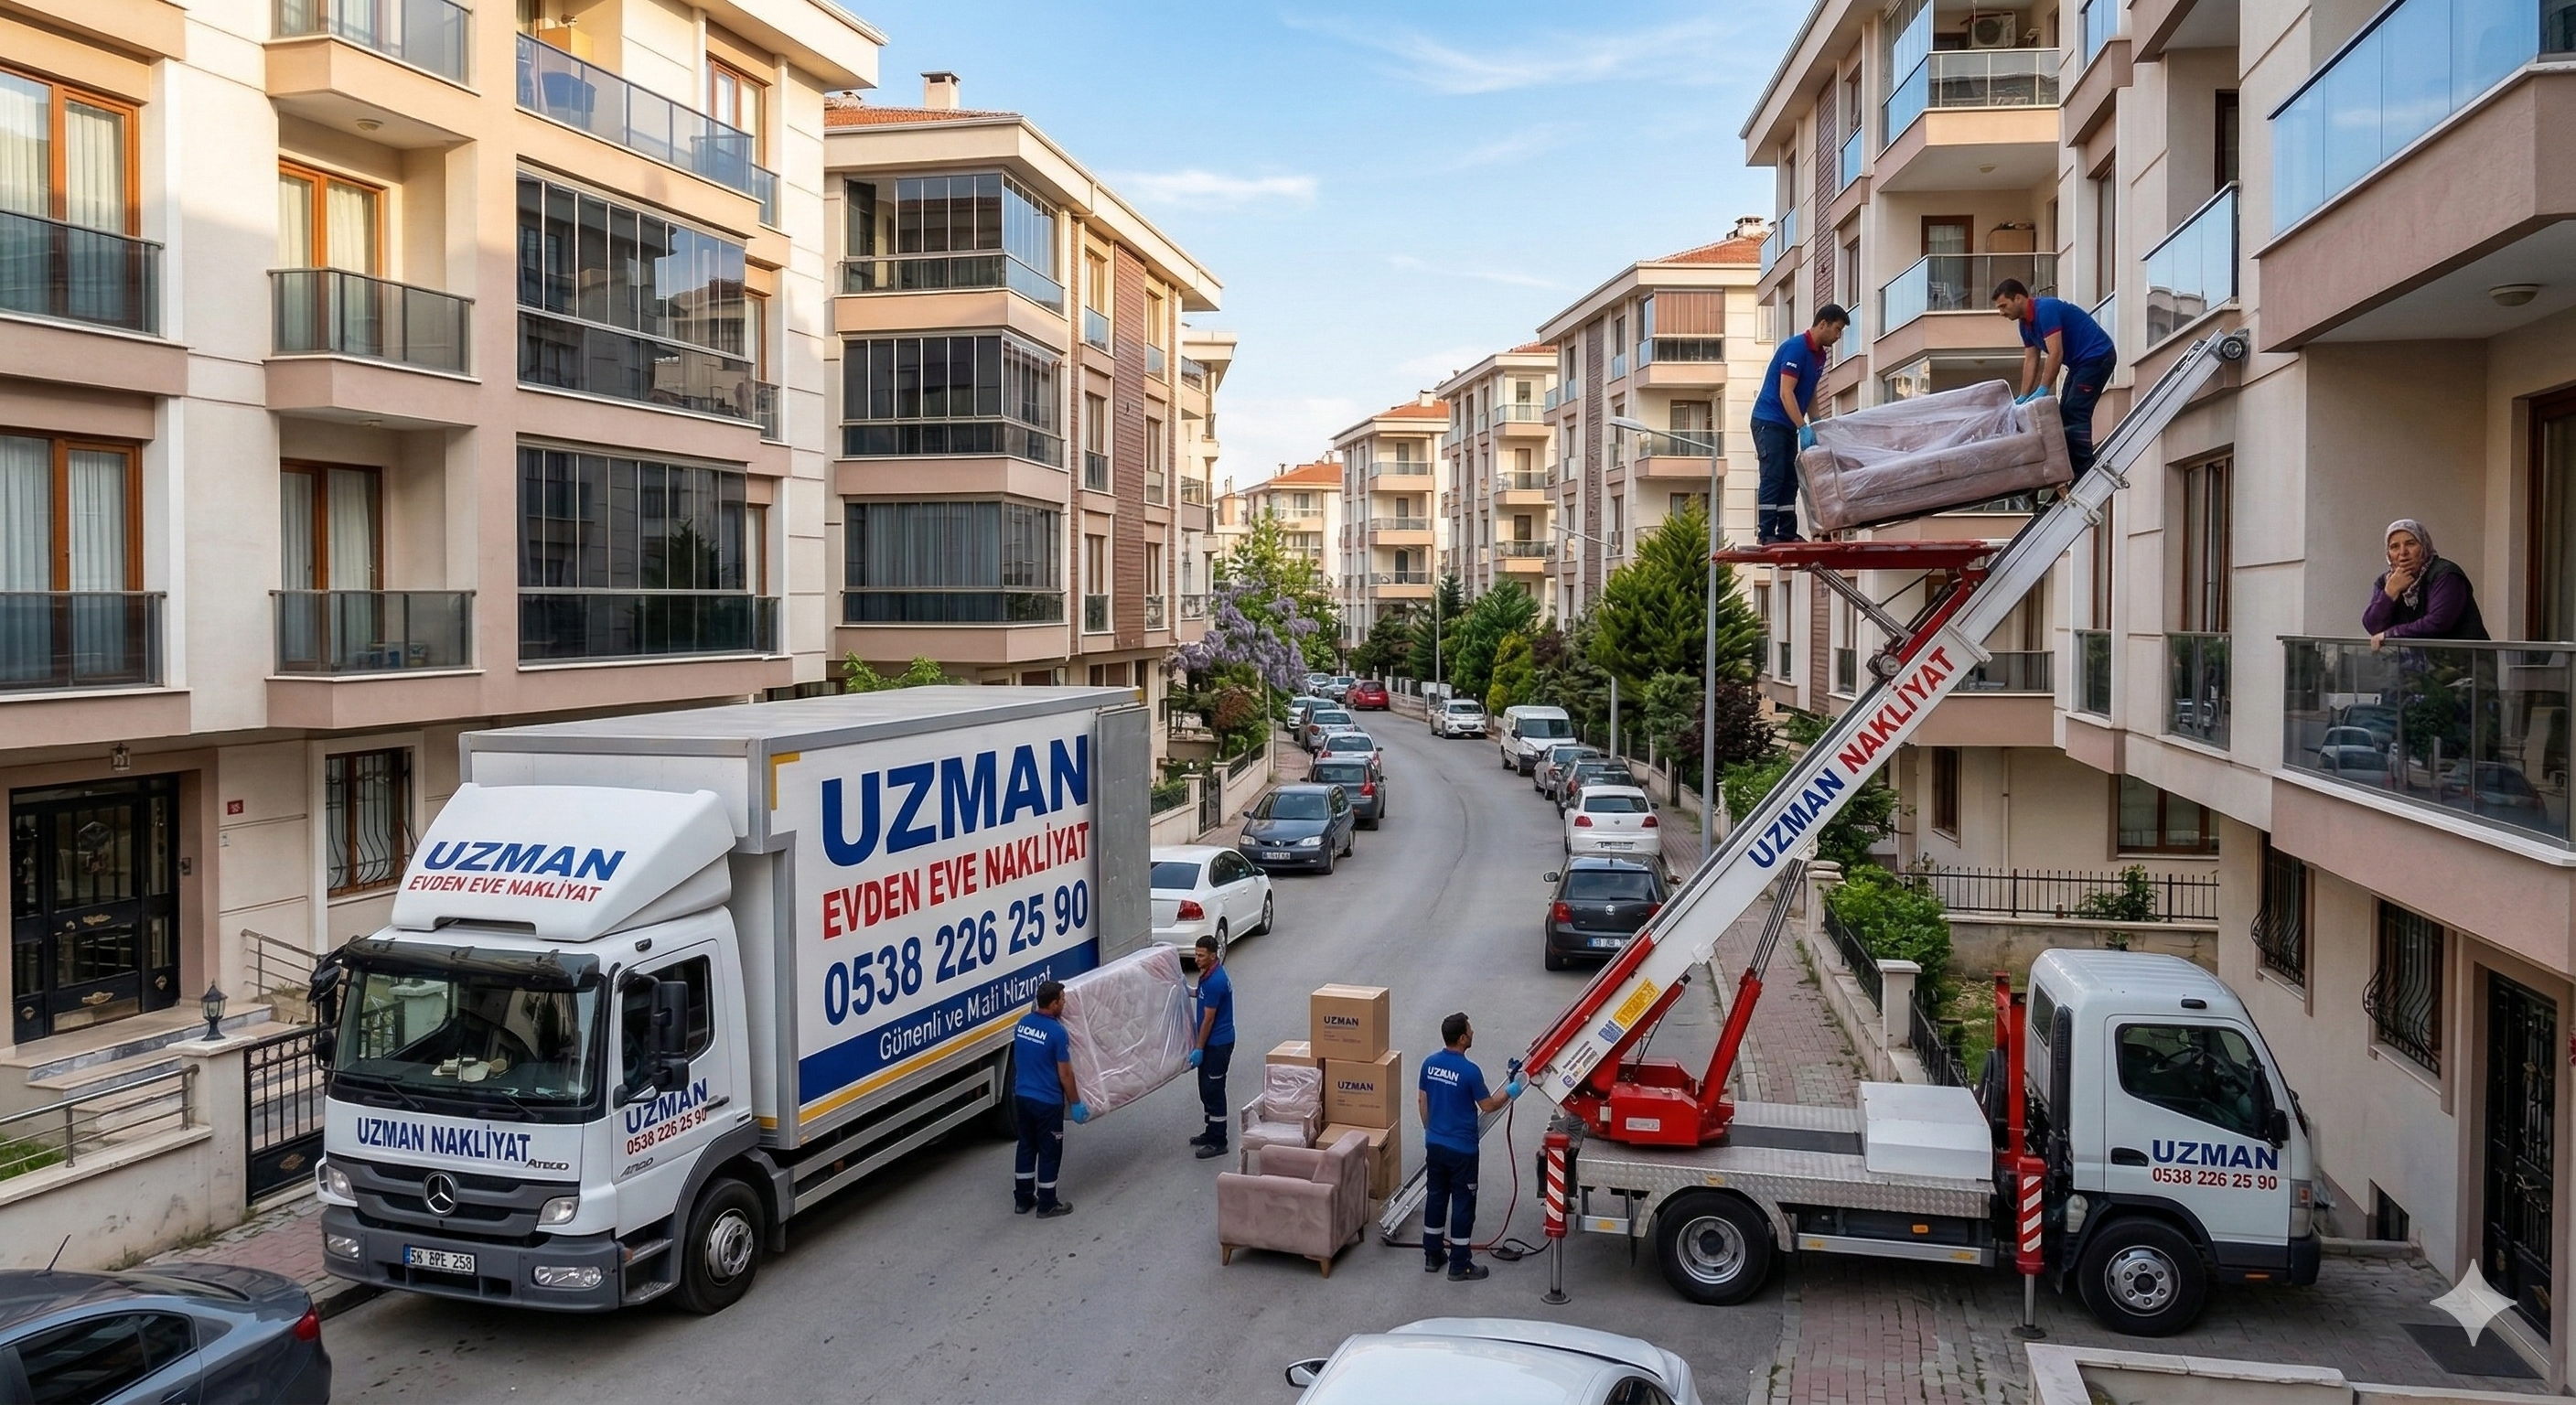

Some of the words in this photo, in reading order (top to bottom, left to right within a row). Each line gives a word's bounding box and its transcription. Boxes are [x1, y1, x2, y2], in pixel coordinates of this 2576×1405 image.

[1747, 767, 1845, 868] UZMAN
[1837, 645, 1955, 775] NAKLİYAT
[821, 735, 1089, 866] UZMAN
[424, 842, 627, 881] UZMAN
[823, 868, 920, 940] EVDEN
[929, 852, 977, 906] EVE
[985, 821, 1089, 888] NAKLİYAT
[408, 875, 468, 892] EVDEN
[468, 877, 506, 894] EVE
[506, 879, 603, 903] NAKLİYAT
[824, 936, 923, 1026] 0538
[935, 910, 997, 984] 226
[1008, 893, 1045, 955] 25
[1055, 879, 1089, 936] 90
[945, 1008, 963, 1031] ve
[1324, 1015, 1359, 1026] UZMAN
[626, 1078, 708, 1134] UZMAN
[1337, 1080, 1374, 1091] UZMAN
[357, 1117, 424, 1153] UZMAN
[431, 1123, 531, 1163] NAKLİYAT
[627, 1130, 655, 1155] 0538
[657, 1121, 677, 1142] 226
[680, 1112, 693, 1132] 25
[695, 1108, 707, 1125] 90
[2152, 1139, 2279, 1171] UZMAN
[2152, 1167, 2192, 1185] 0538
[2197, 1170, 2227, 1187] 226
[2232, 1173, 2253, 1189] 25
[2257, 1174, 2278, 1191] 90
